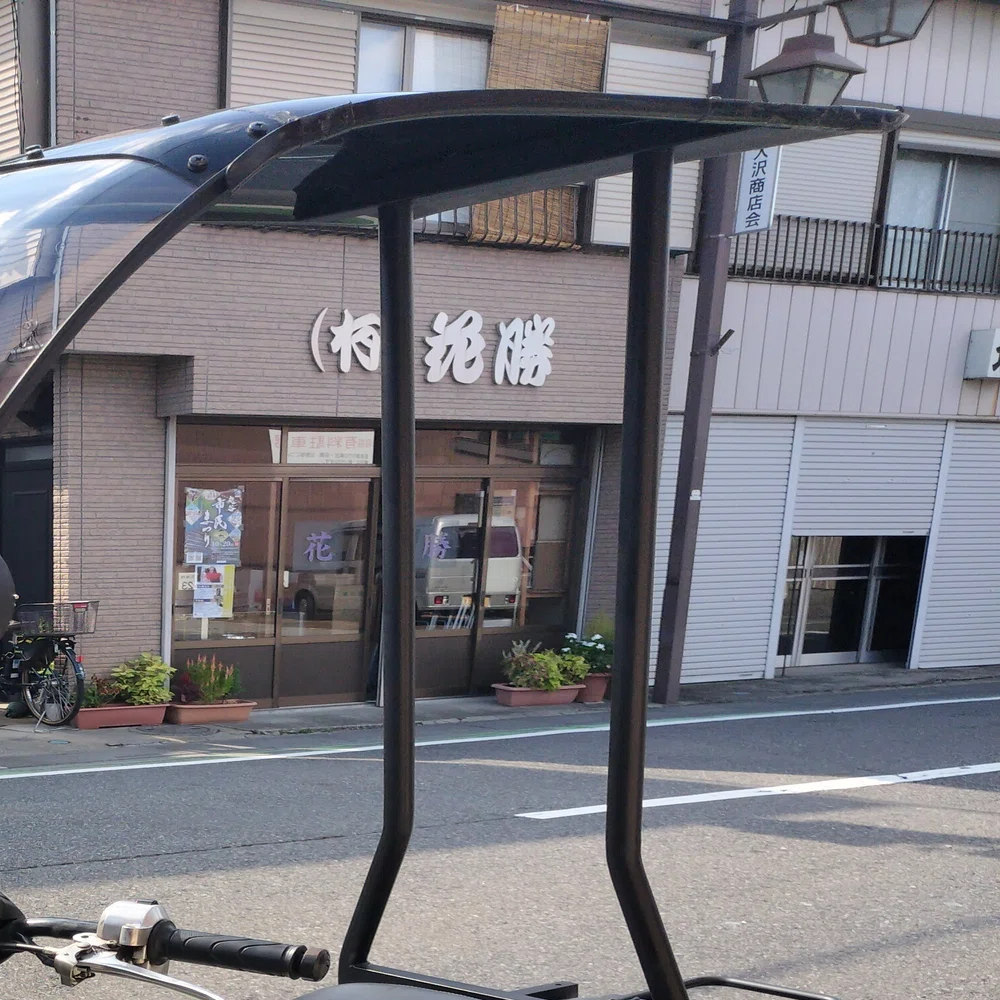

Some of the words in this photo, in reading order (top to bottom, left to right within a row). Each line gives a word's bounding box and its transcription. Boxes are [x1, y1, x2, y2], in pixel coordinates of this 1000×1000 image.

[200, 509, 214, 548] まつり
[212, 497, 228, 530] 市民
[303, 531, 334, 562] 花
[422, 532, 452, 560] 勝
